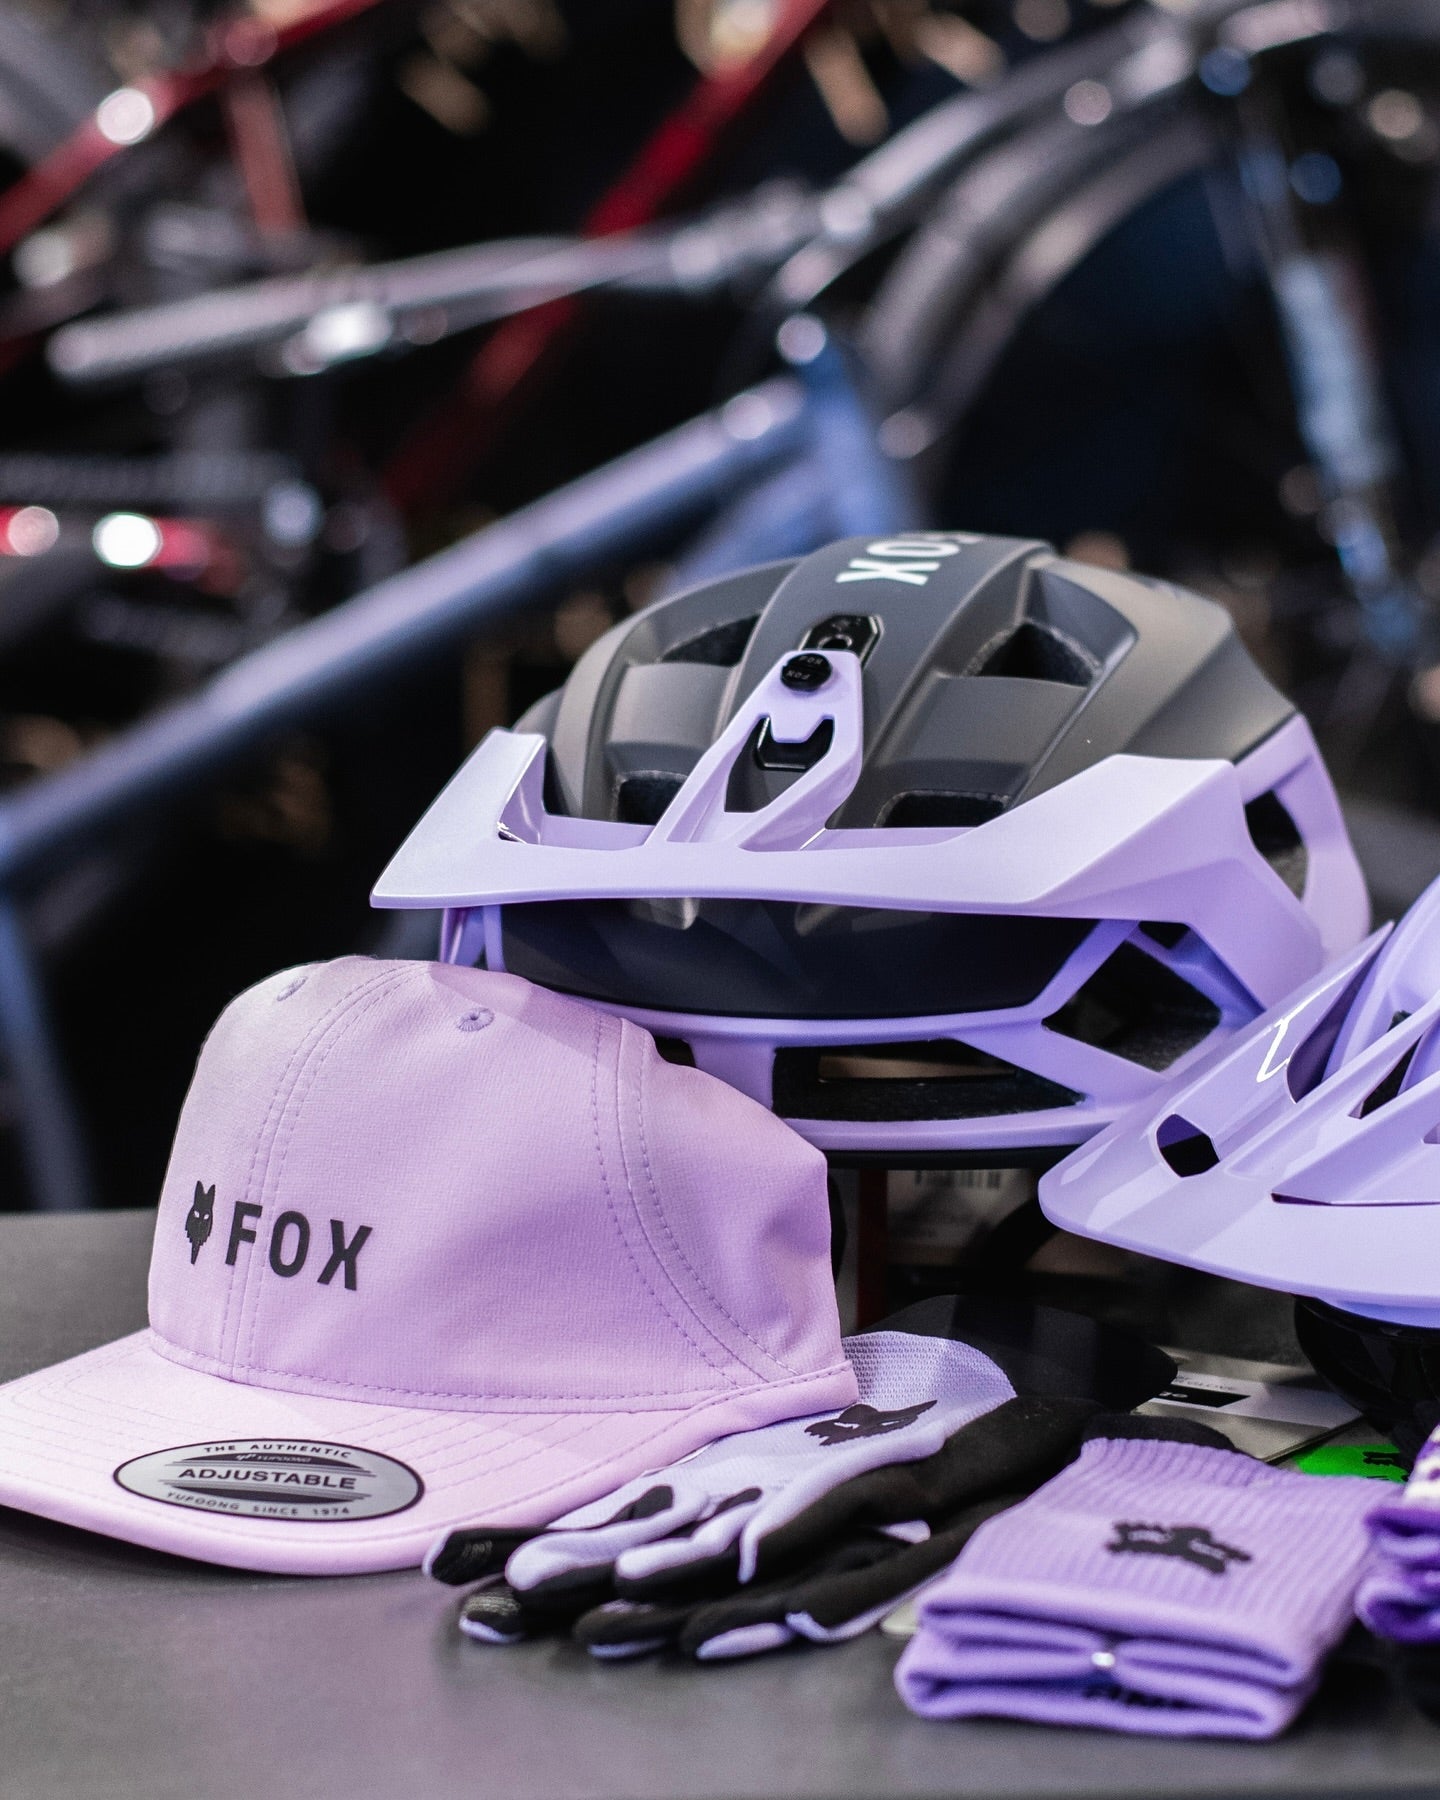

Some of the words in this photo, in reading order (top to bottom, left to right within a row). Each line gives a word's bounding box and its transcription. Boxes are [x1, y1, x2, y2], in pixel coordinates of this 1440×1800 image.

[225, 1200, 373, 1291] FOX
[203, 1445, 236, 1453] THE
[250, 1444, 352, 1459] AUTHENTIC
[178, 1468, 357, 1490] ADJUSTABLE
[166, 1491, 240, 1511] YUPOONG
[252, 1505, 299, 1516] SINCE
[312, 1506, 350, 1516] 1974
